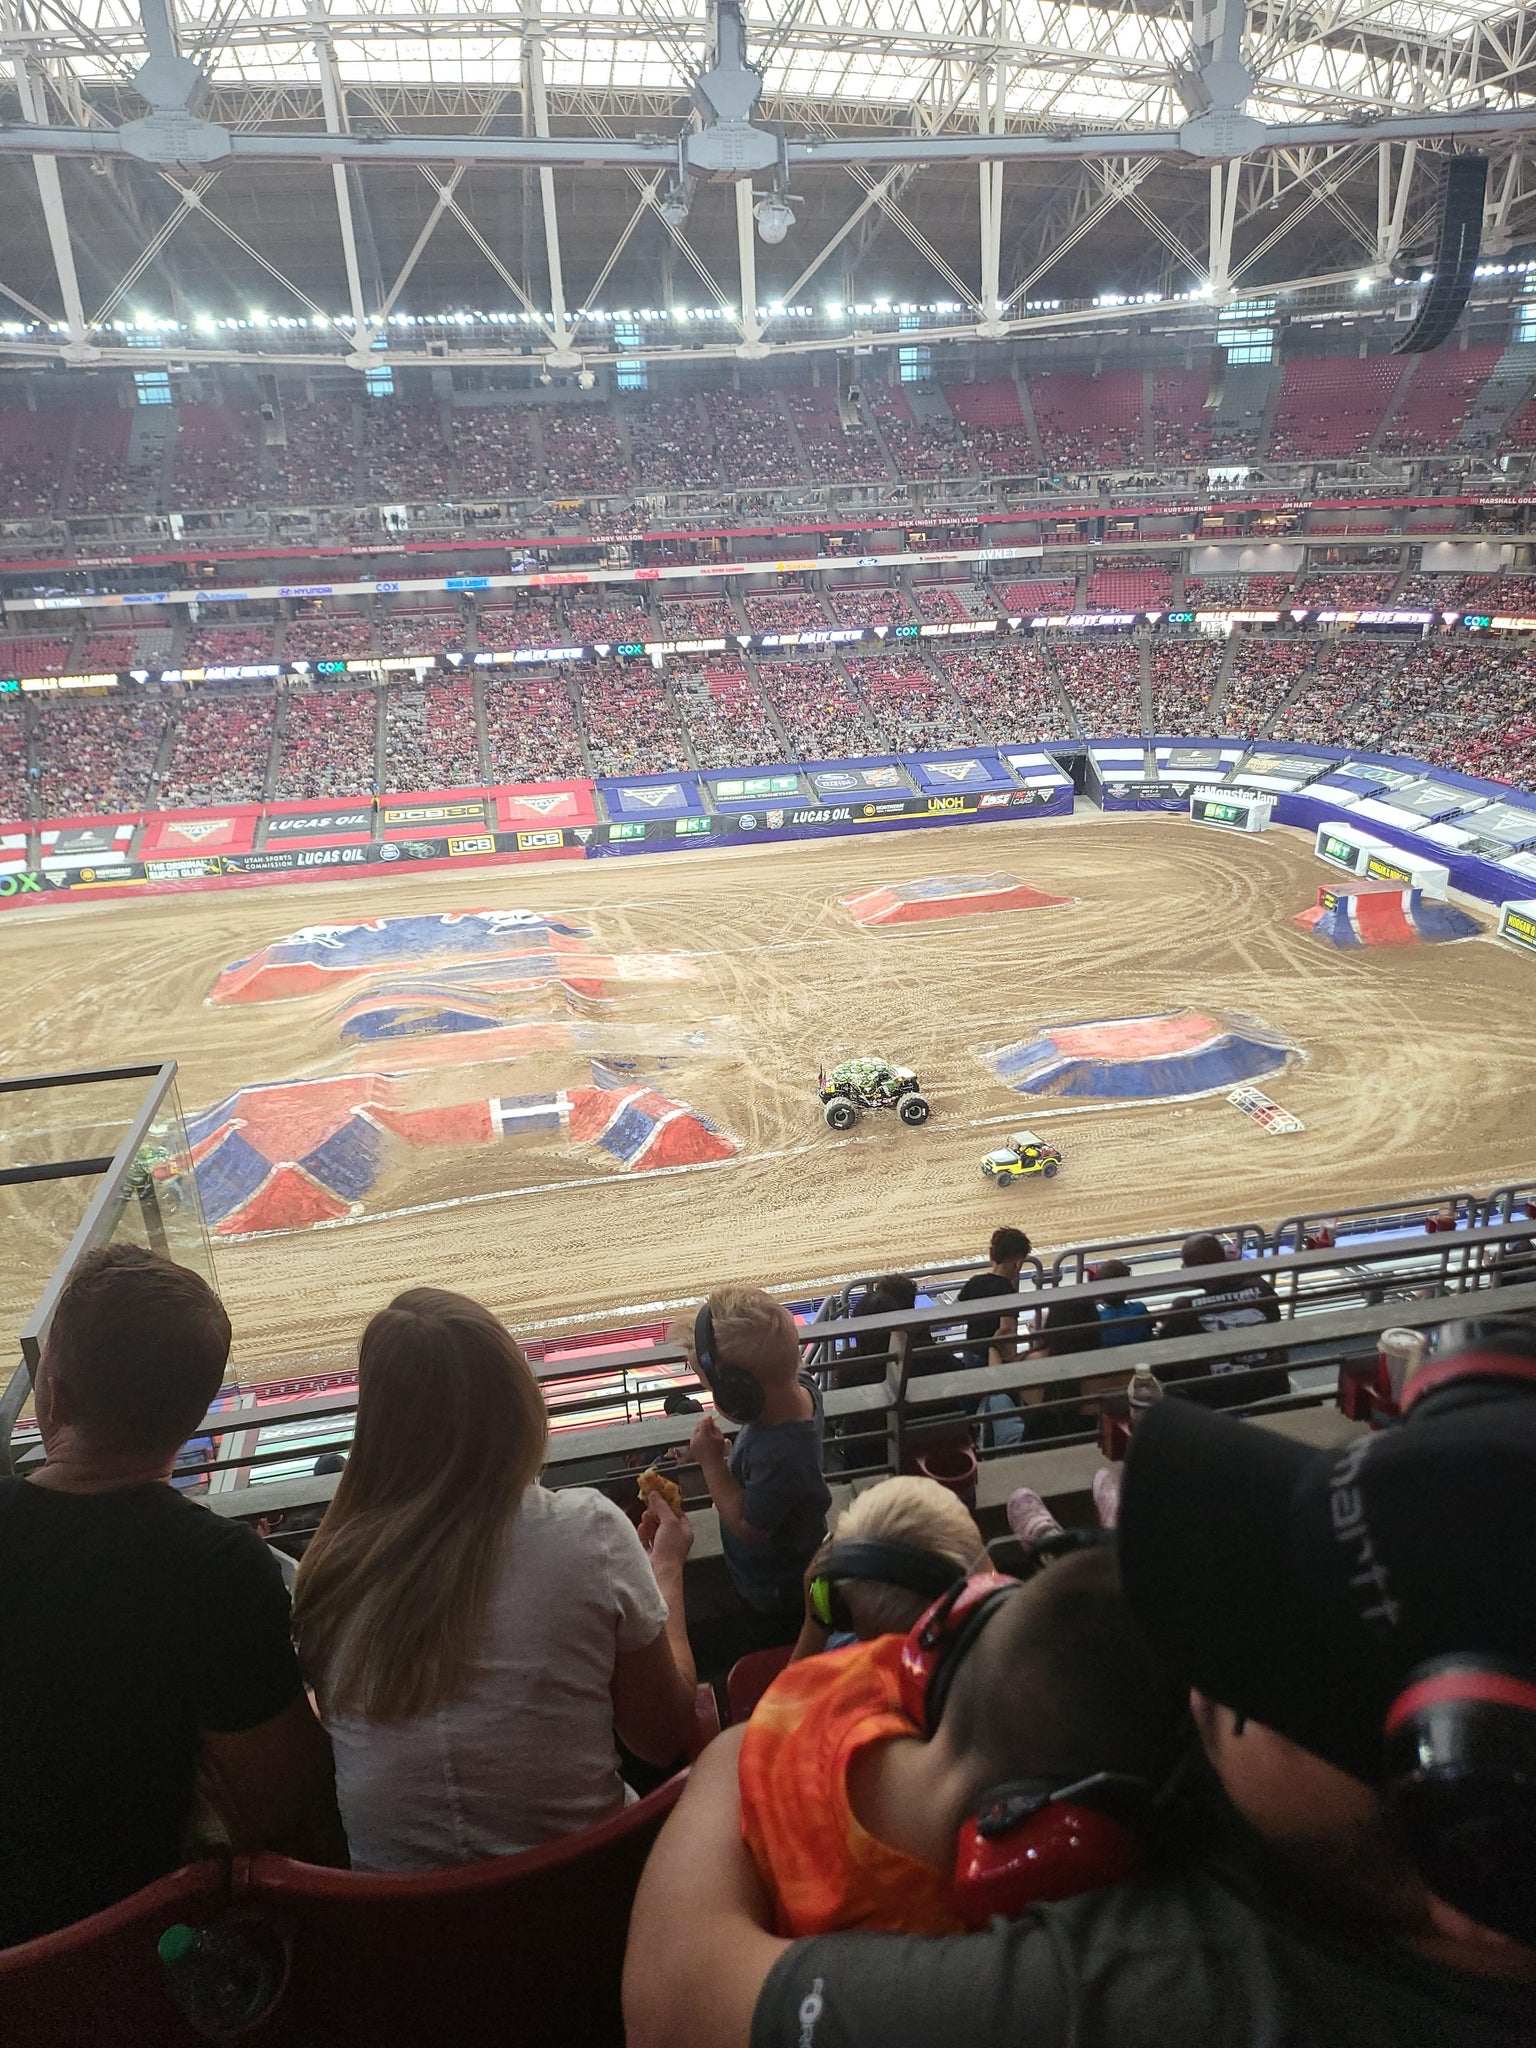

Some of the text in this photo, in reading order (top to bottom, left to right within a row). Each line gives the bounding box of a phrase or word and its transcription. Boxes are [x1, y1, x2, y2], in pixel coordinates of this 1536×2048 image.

[978, 549, 1017, 560] AVNET
[294, 587, 332, 595] HYUNDAI
[376, 583, 399, 591] COX
[1168, 612, 1193, 622] COX
[1464, 615, 1490, 627] COX
[895, 626, 918, 637] COX
[617, 644, 642, 655] COX
[317, 661, 344, 674] COX
[1352, 765, 1400, 781] COX
[717, 776, 797, 796] BKT
[1013, 797, 1033, 805] CARS
[1193, 785, 1278, 806] #MonsterJam
[928, 797, 965, 810] UNOH
[389, 808, 445, 820] JCB
[793, 810, 830, 824] LUCAS
[1204, 803, 1238, 821] BKT
[268, 817, 332, 831] LUCAS
[609, 823, 645, 838] BKT
[676, 817, 711, 833] BKT
[452, 839, 491, 852] JCB
[522, 834, 560, 847] JCB
[1326, 838, 1350, 859] BKT
[297, 850, 340, 866] LUCAS
[147, 860, 207, 871] THE ORIGINAL
[245, 861, 293, 869] COMMISSION
[1369, 860, 1386, 876] MORGAN
[149, 867, 205, 880] SUPER GLUE
[1508, 915, 1532, 934] MORGAN
